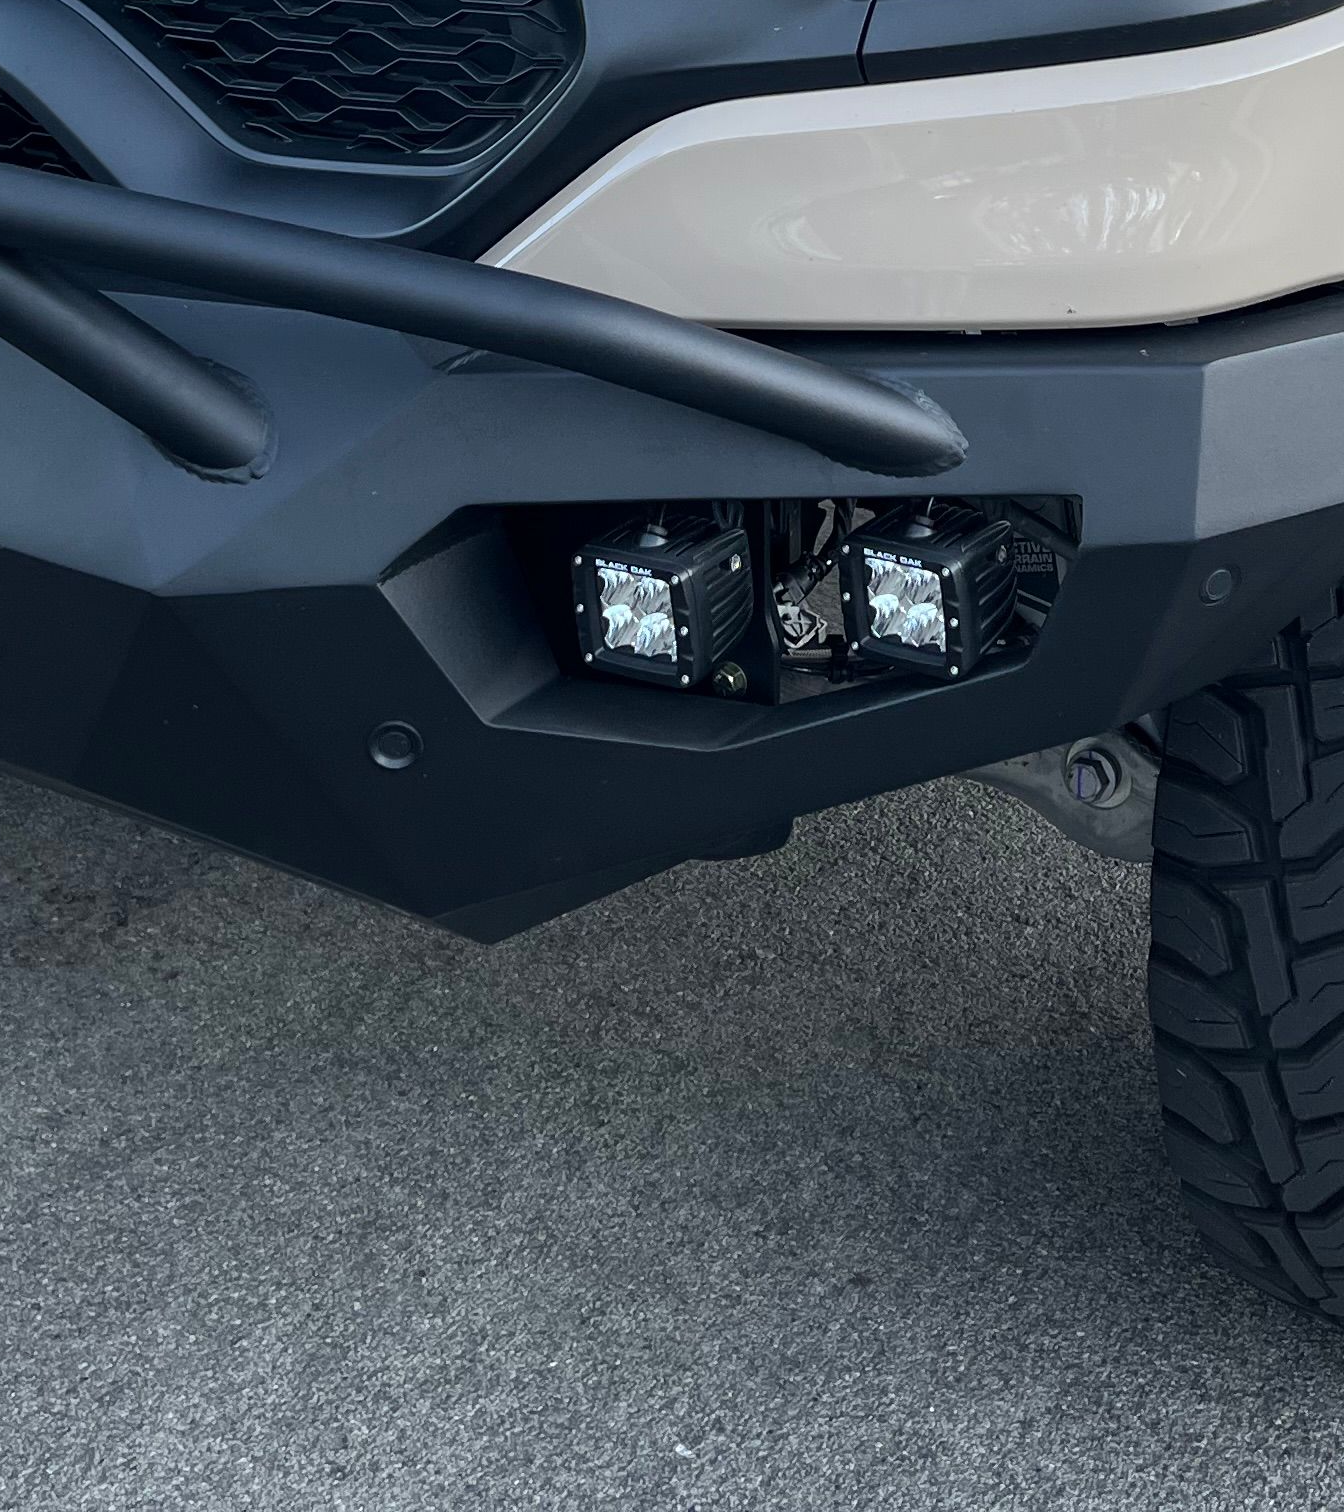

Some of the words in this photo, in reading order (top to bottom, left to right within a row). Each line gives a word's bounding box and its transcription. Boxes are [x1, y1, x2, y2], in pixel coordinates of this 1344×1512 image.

[595, 557, 629, 571] BLACK
[630, 565, 653, 577] OAK
[863, 547, 898, 563] BLACK
[899, 556, 923, 568] OAK
